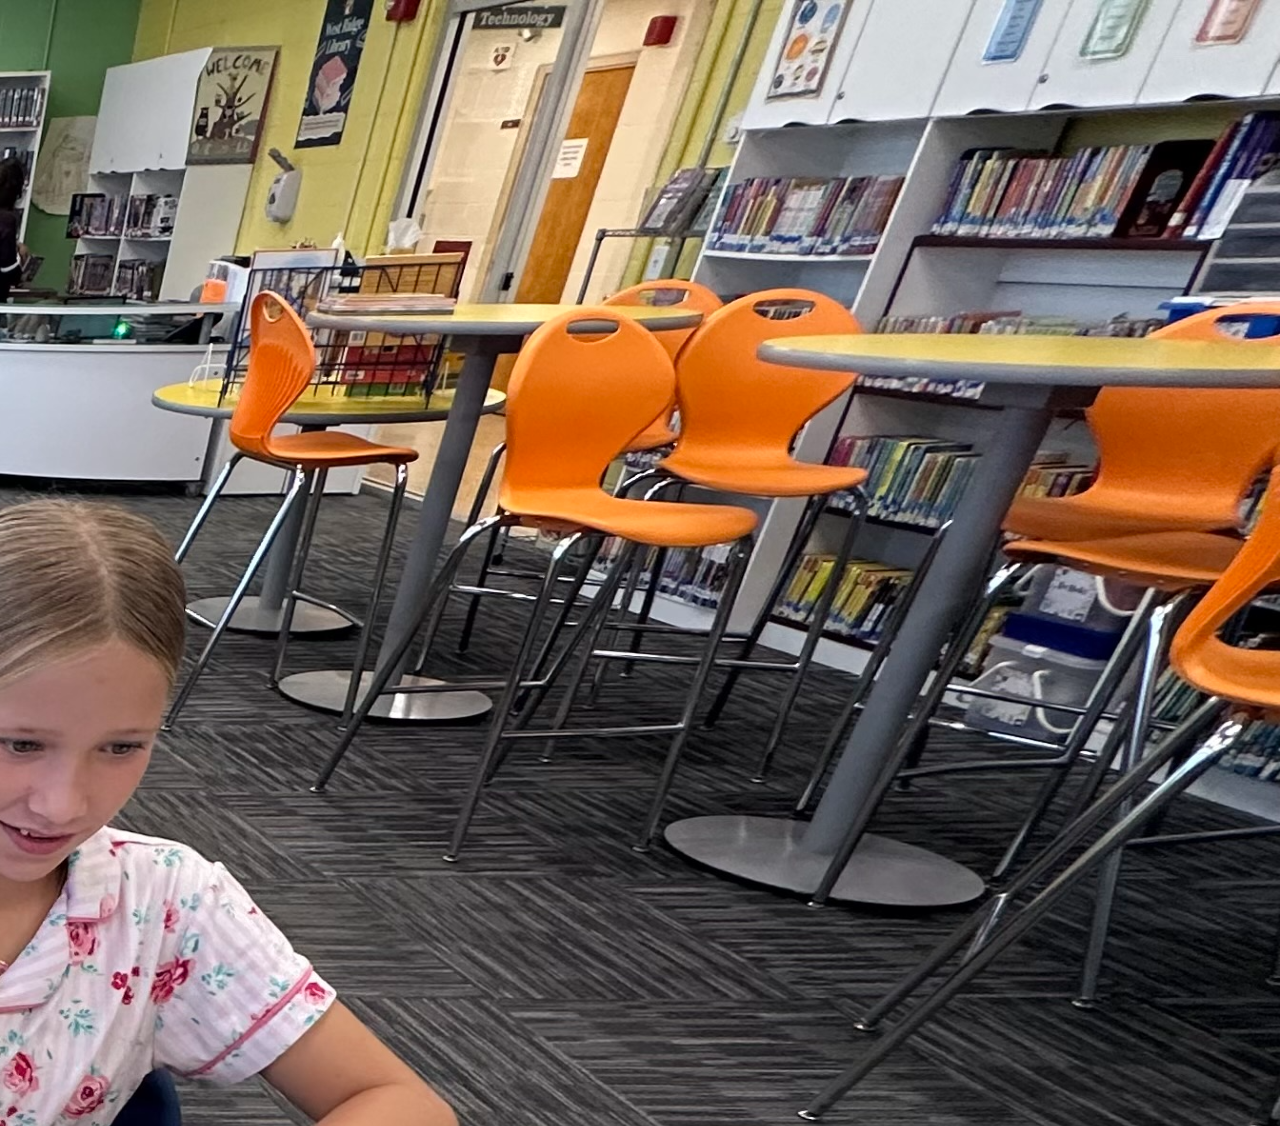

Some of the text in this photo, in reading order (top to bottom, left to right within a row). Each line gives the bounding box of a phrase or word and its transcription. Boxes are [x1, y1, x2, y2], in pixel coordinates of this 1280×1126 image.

[480, 12, 555, 26] Technology
[325, 39, 351, 55] Library
[206, 54, 271, 76] WELCOME
